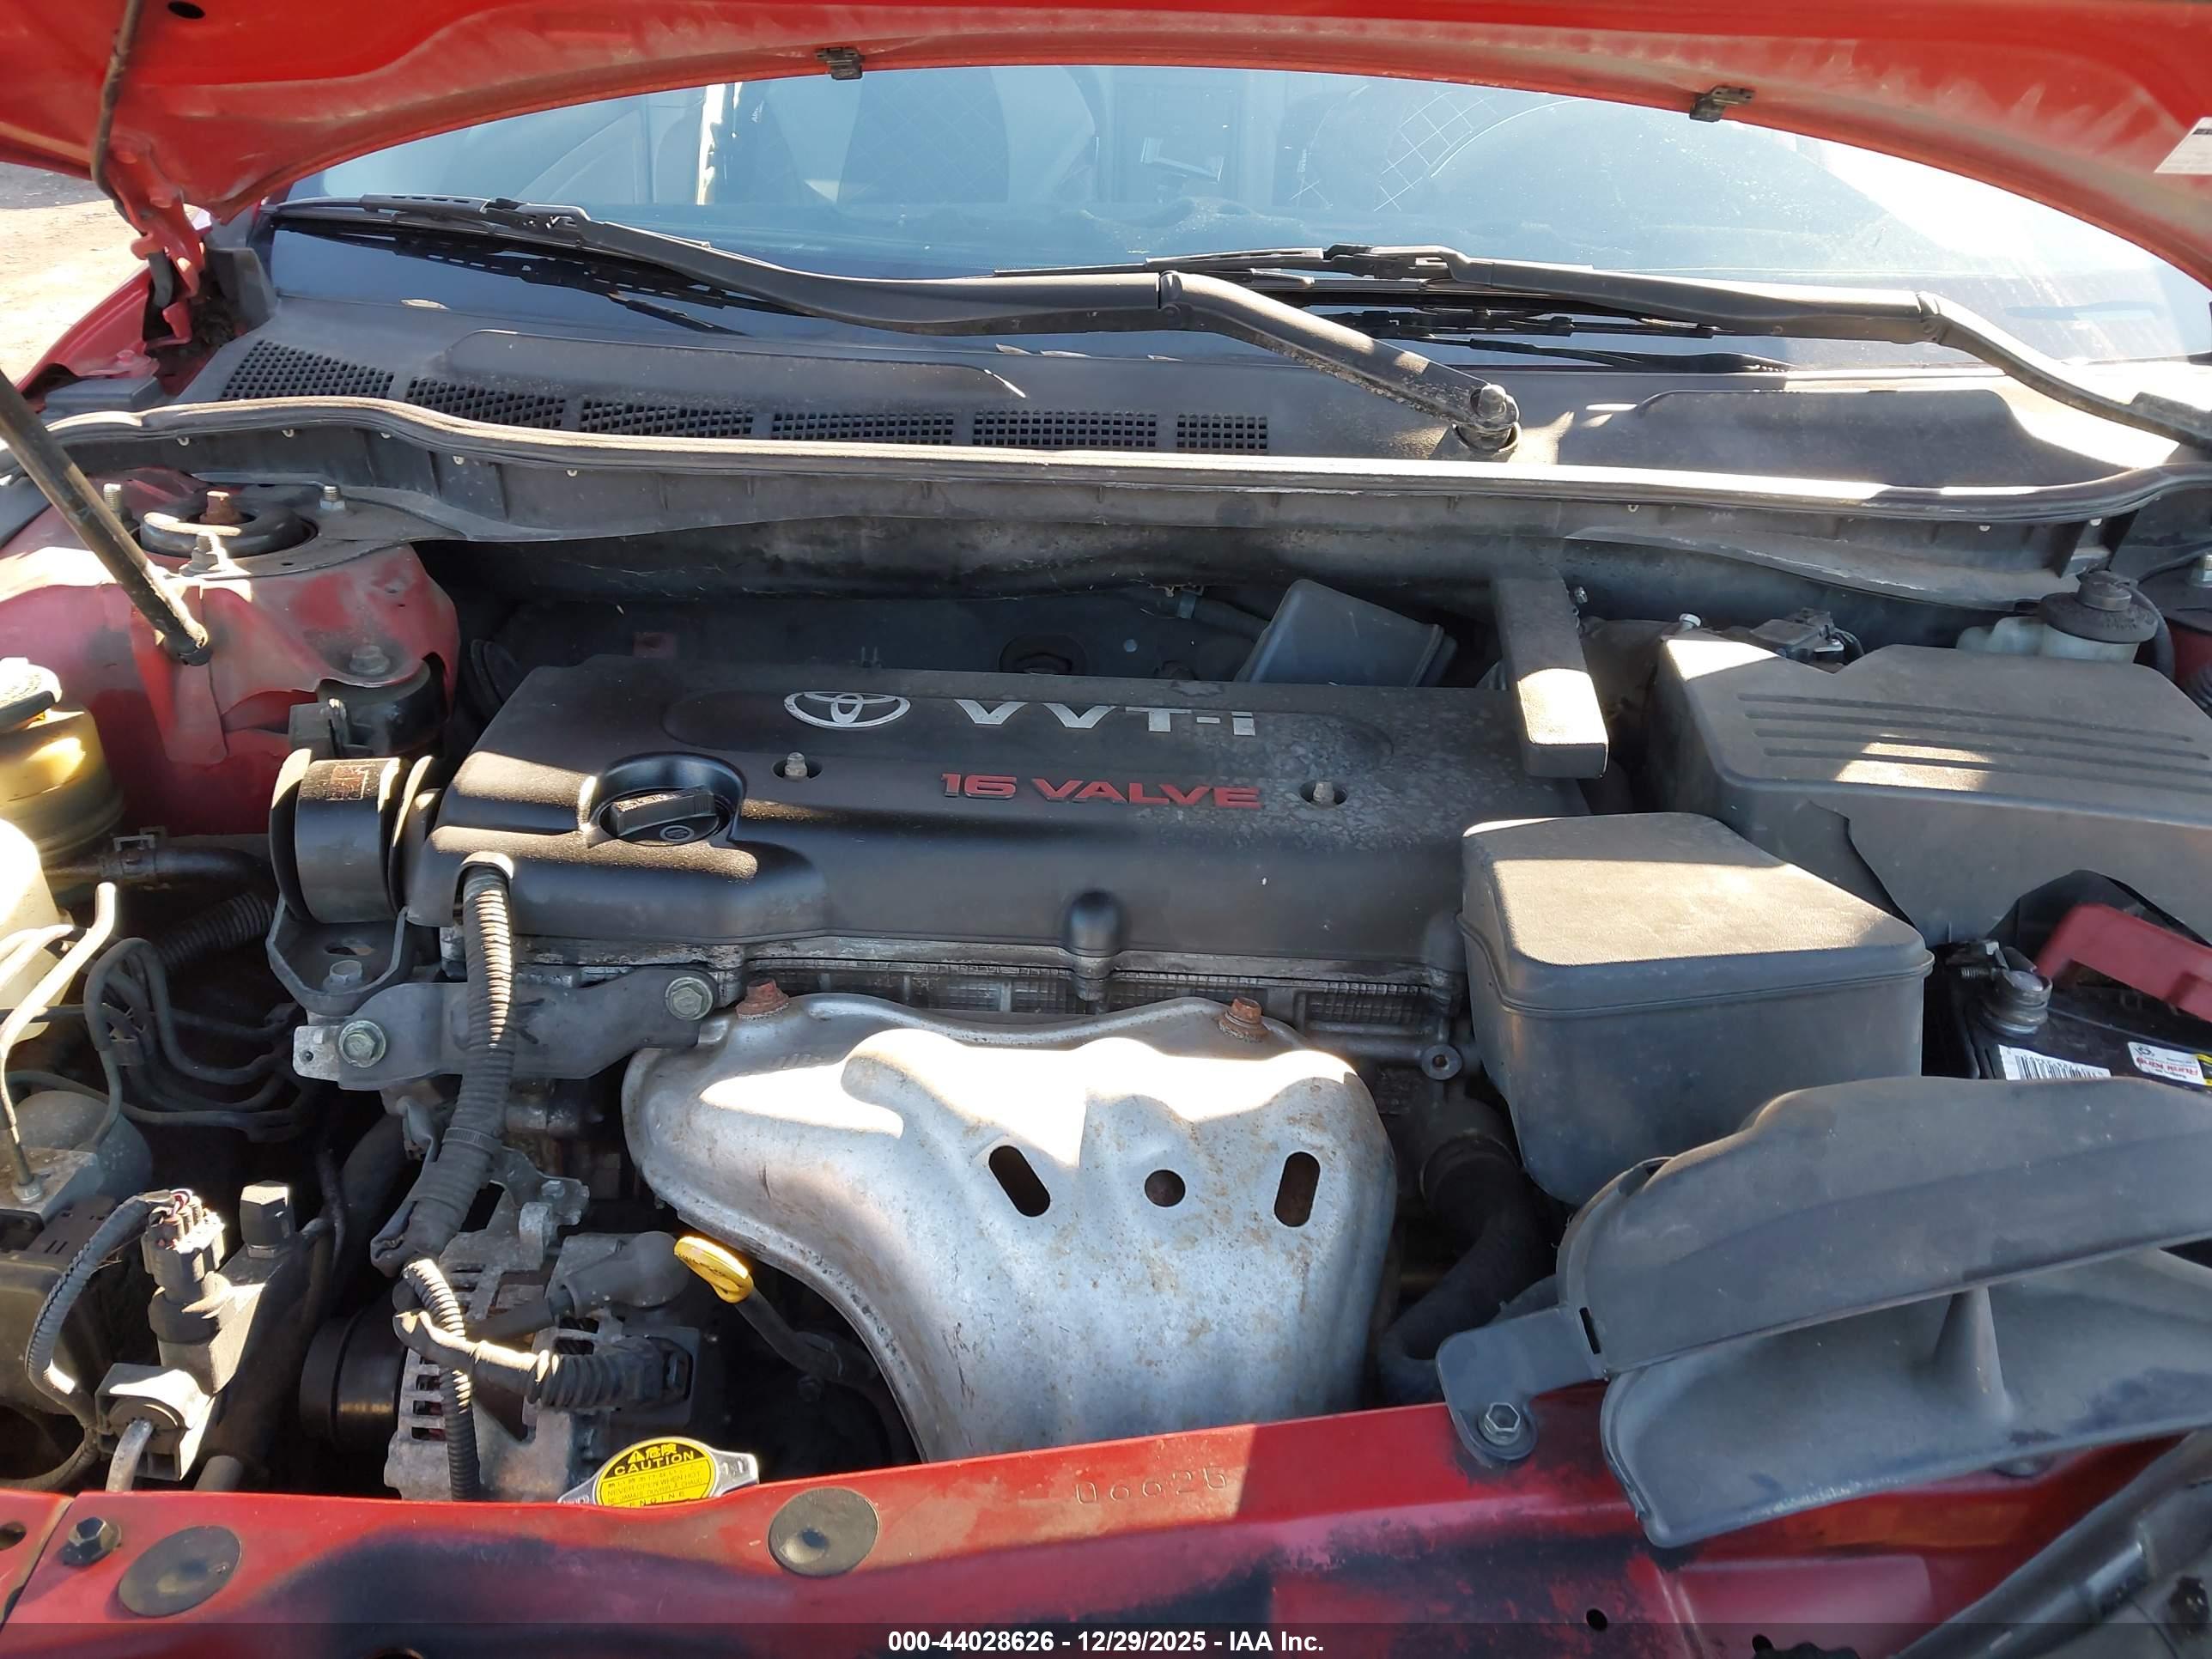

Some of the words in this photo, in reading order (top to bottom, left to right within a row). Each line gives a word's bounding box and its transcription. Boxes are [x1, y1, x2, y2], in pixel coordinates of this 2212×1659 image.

[954, 699, 1256, 736] VVT-i
[941, 773, 1018, 799] 16
[1030, 777, 1262, 810] VALVE
[614, 1450, 695, 1476] CAUTION
[607, 1483, 635, 1497] NEVER
[635, 1480, 659, 1491] OPEN
[659, 1474, 684, 1486] WHEN
